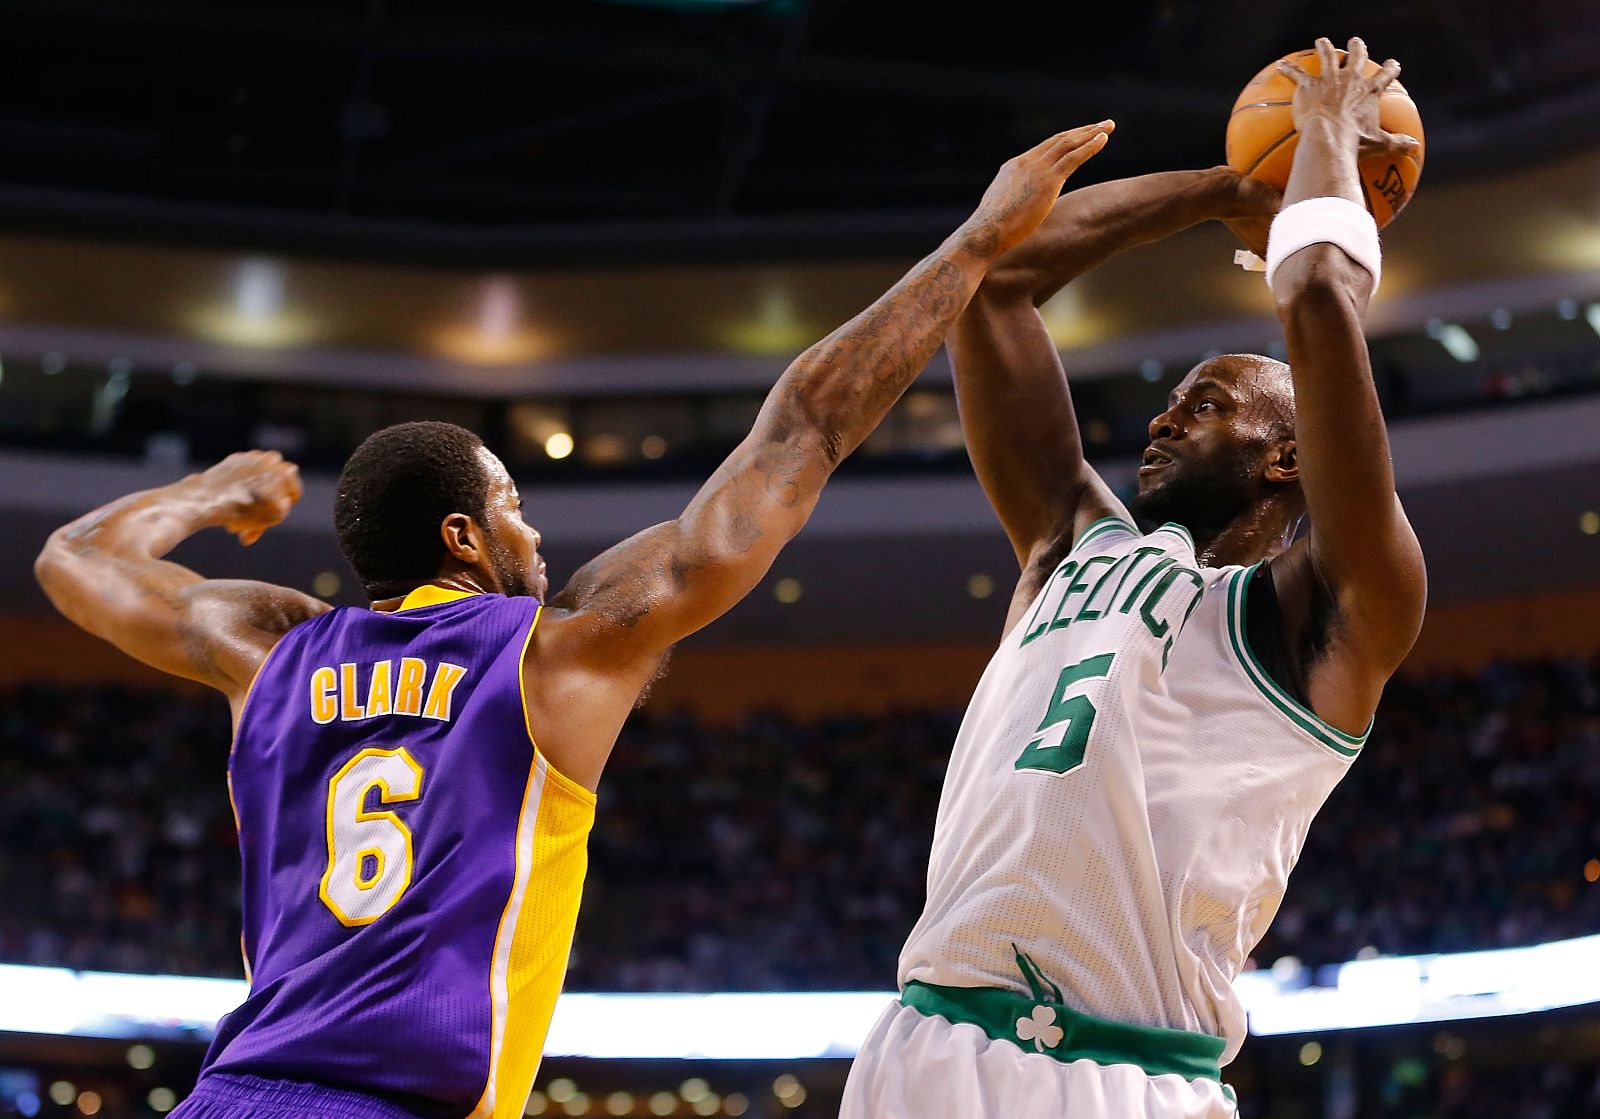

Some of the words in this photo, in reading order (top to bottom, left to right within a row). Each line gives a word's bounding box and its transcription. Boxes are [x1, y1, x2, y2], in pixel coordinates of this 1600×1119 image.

[310, 657, 468, 725] CLARK
[1013, 652, 1117, 778] 5
[318, 746, 423, 928] 6
